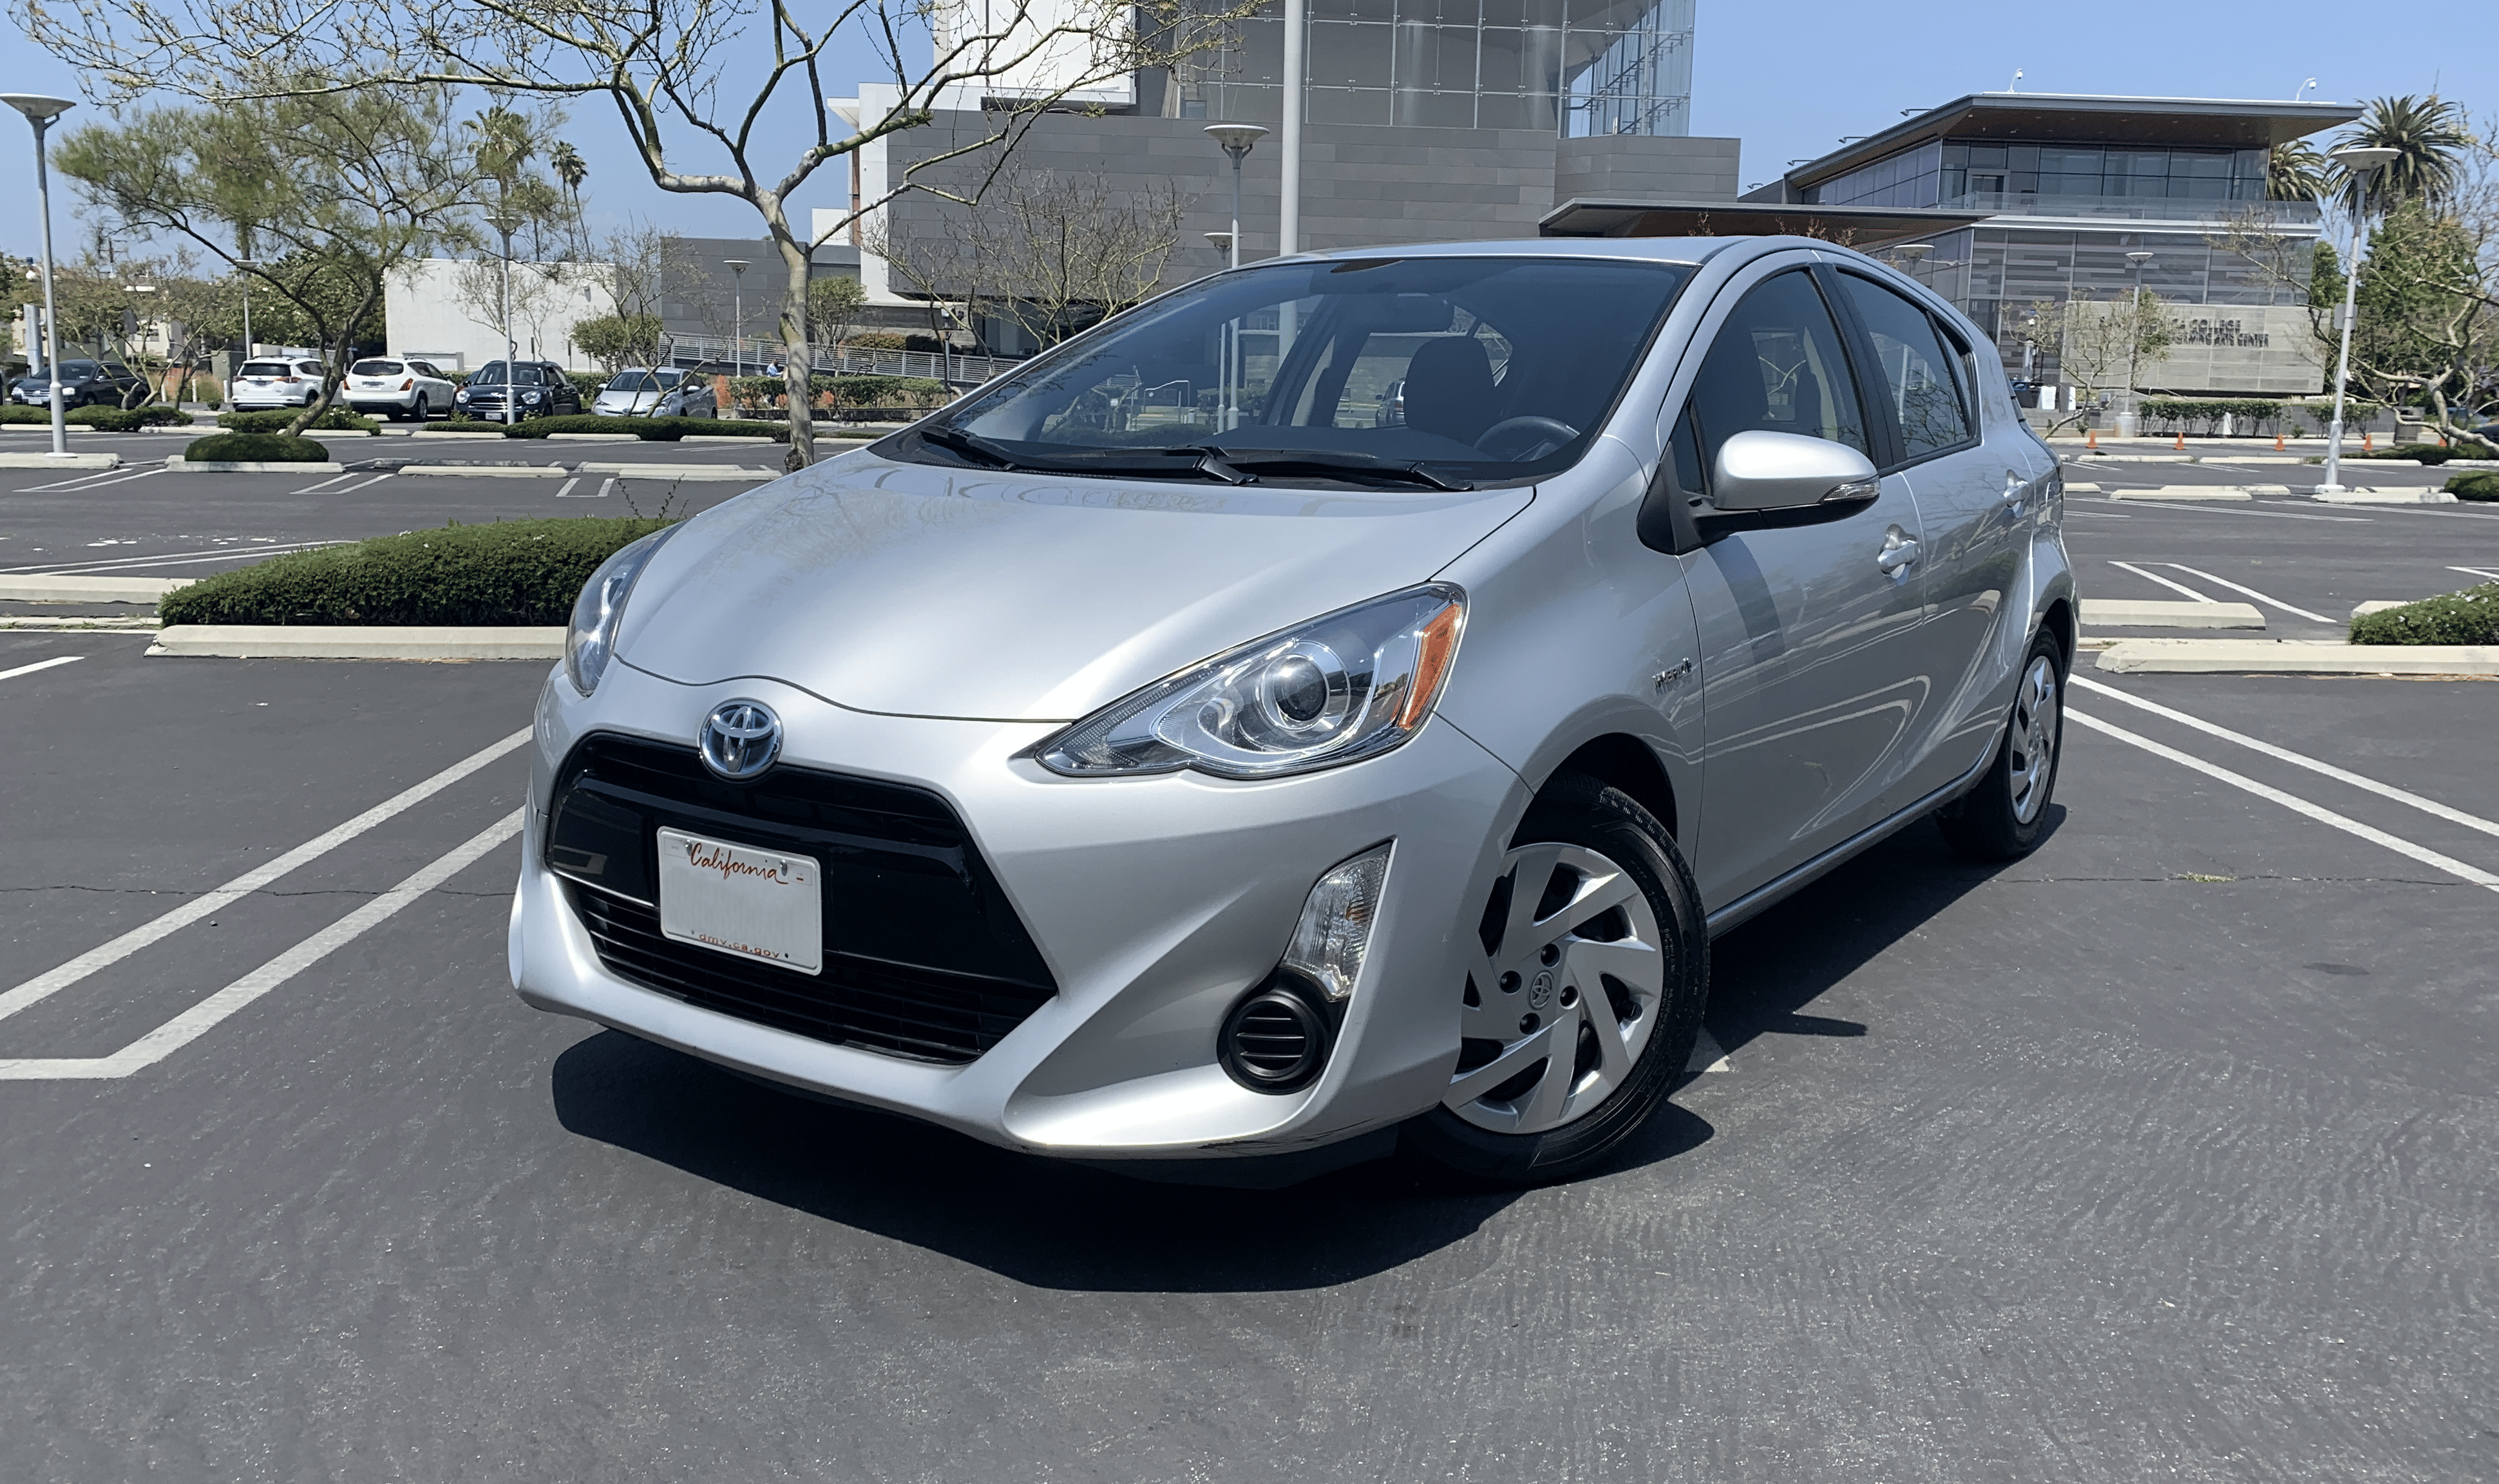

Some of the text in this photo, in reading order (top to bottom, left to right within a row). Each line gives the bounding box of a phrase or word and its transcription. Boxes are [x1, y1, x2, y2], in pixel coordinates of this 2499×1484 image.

[2190, 318, 2241, 331] COLLEGE
[2215, 332, 2235, 346] ARTS
[2238, 333, 2270, 347] CENTER
[690, 842, 789, 885] California
[699, 933, 780, 958] dmv.ca.gov
